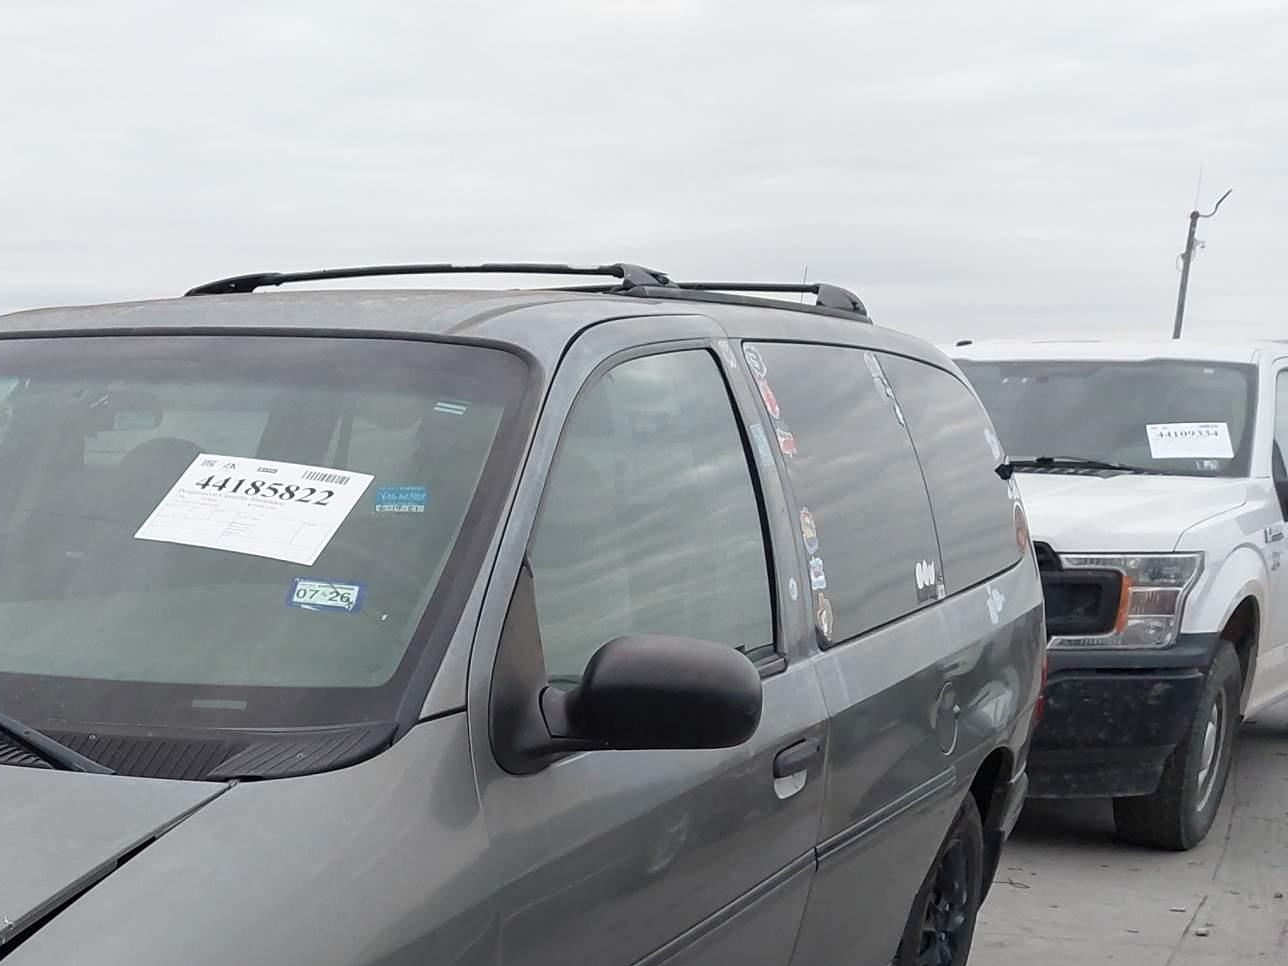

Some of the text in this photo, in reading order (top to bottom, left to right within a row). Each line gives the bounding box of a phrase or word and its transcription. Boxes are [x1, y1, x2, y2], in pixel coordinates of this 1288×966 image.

[195, 474, 335, 506] 44185822
[296, 588, 352, 603] 07 26
